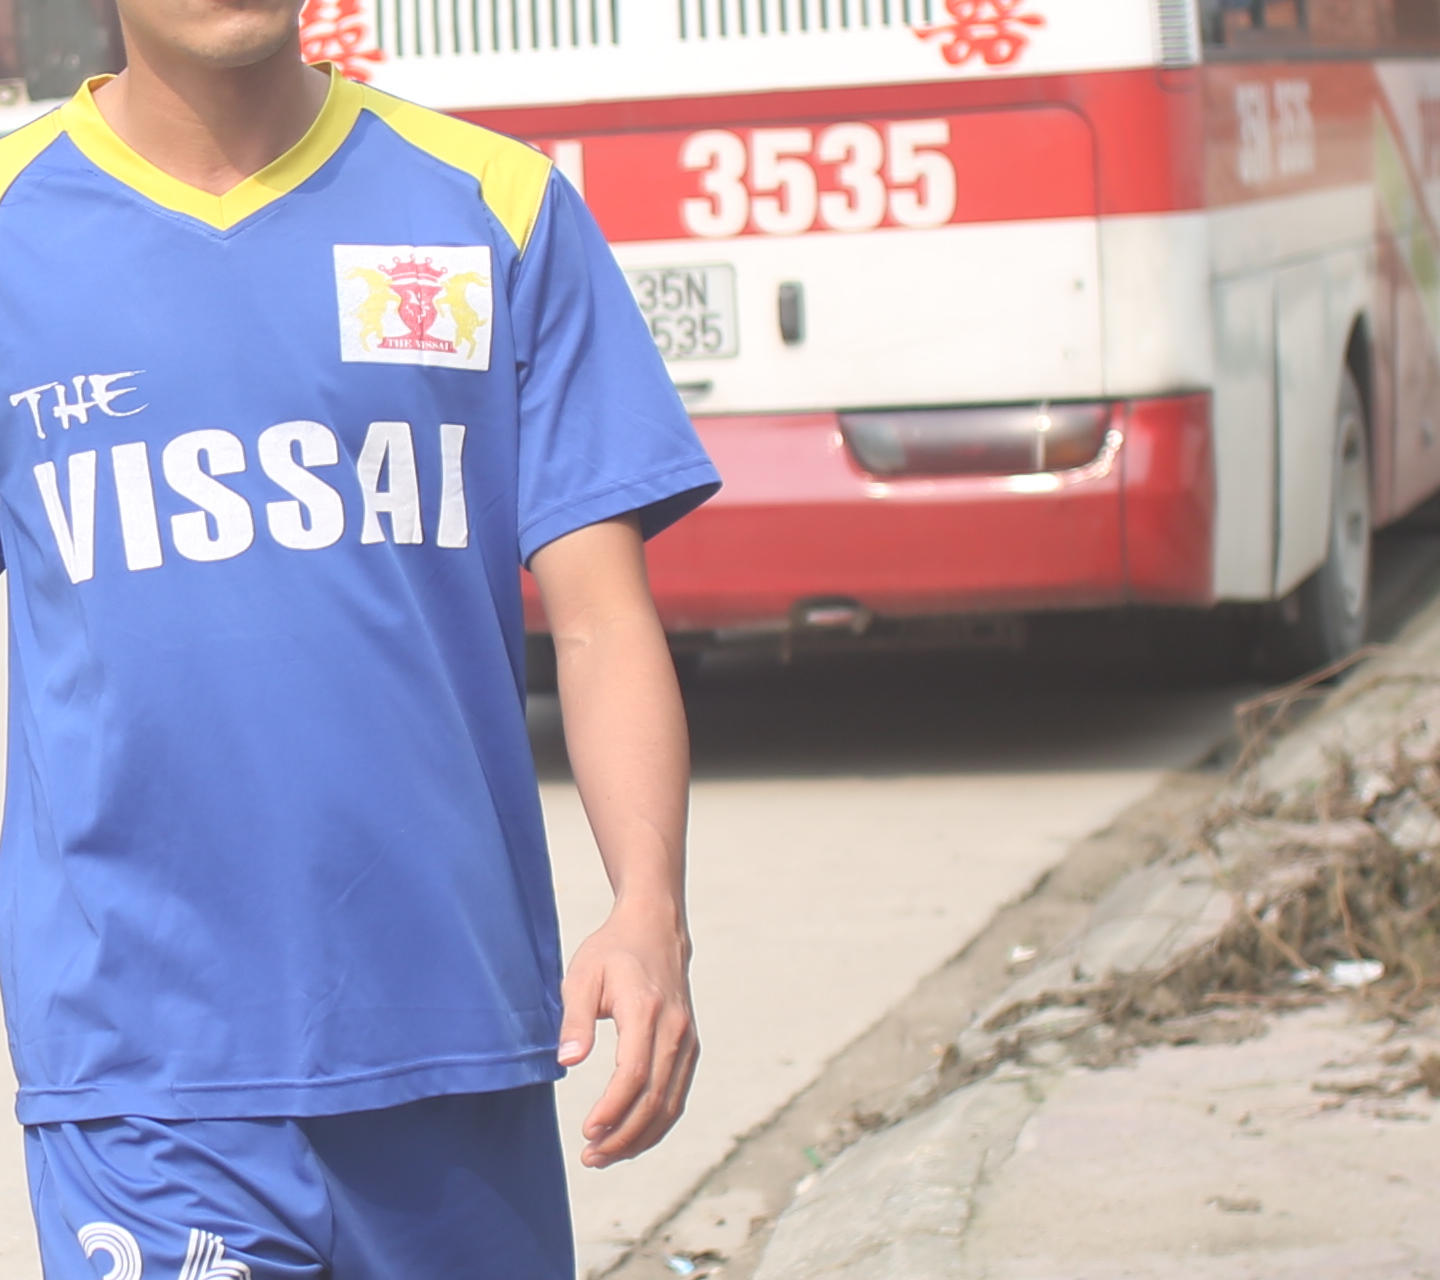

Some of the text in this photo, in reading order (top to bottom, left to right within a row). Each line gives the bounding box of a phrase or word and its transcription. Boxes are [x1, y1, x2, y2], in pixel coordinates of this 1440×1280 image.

[681, 118, 957, 238] 3535
[637, 272, 708, 312] 35N
[387, 338, 450, 351] THE VISSAI
[653, 313, 724, 354] 535
[9, 369, 150, 440] THE
[32, 420, 469, 585] VISSAI
